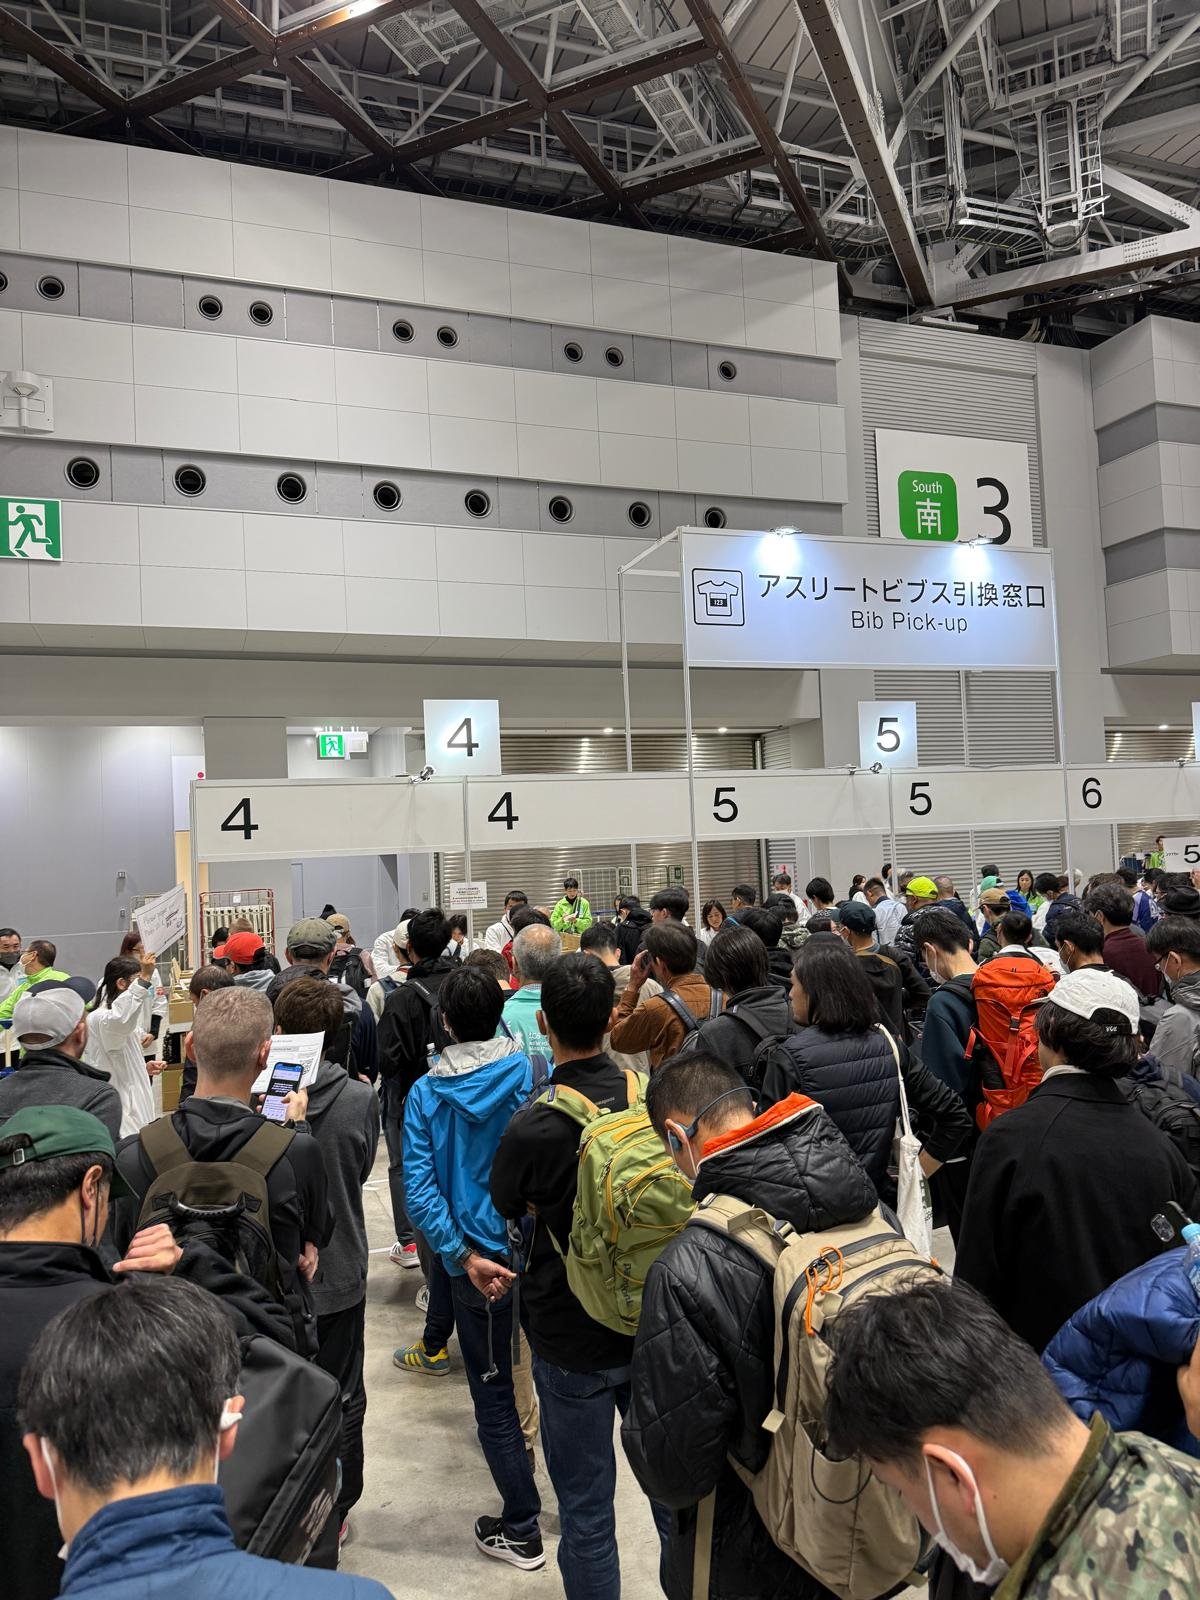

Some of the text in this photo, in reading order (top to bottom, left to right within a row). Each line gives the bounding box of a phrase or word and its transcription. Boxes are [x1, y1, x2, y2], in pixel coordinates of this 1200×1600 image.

[912, 479, 943, 494] South
[915, 498, 942, 535] 南
[976, 477, 1012, 546] 3
[758, 574, 1046, 608] アスリートビブス引換窓口
[851, 610, 968, 634] Bib Pick-up
[446, 717, 480, 757] 4
[876, 717, 901, 752] 5
[712, 786, 739, 823] 5
[909, 781, 933, 816] 5
[1081, 777, 1102, 809] 6
[220, 797, 259, 840] 4
[487, 791, 519, 831] 4
[1184, 844, 1200, 863] 5
